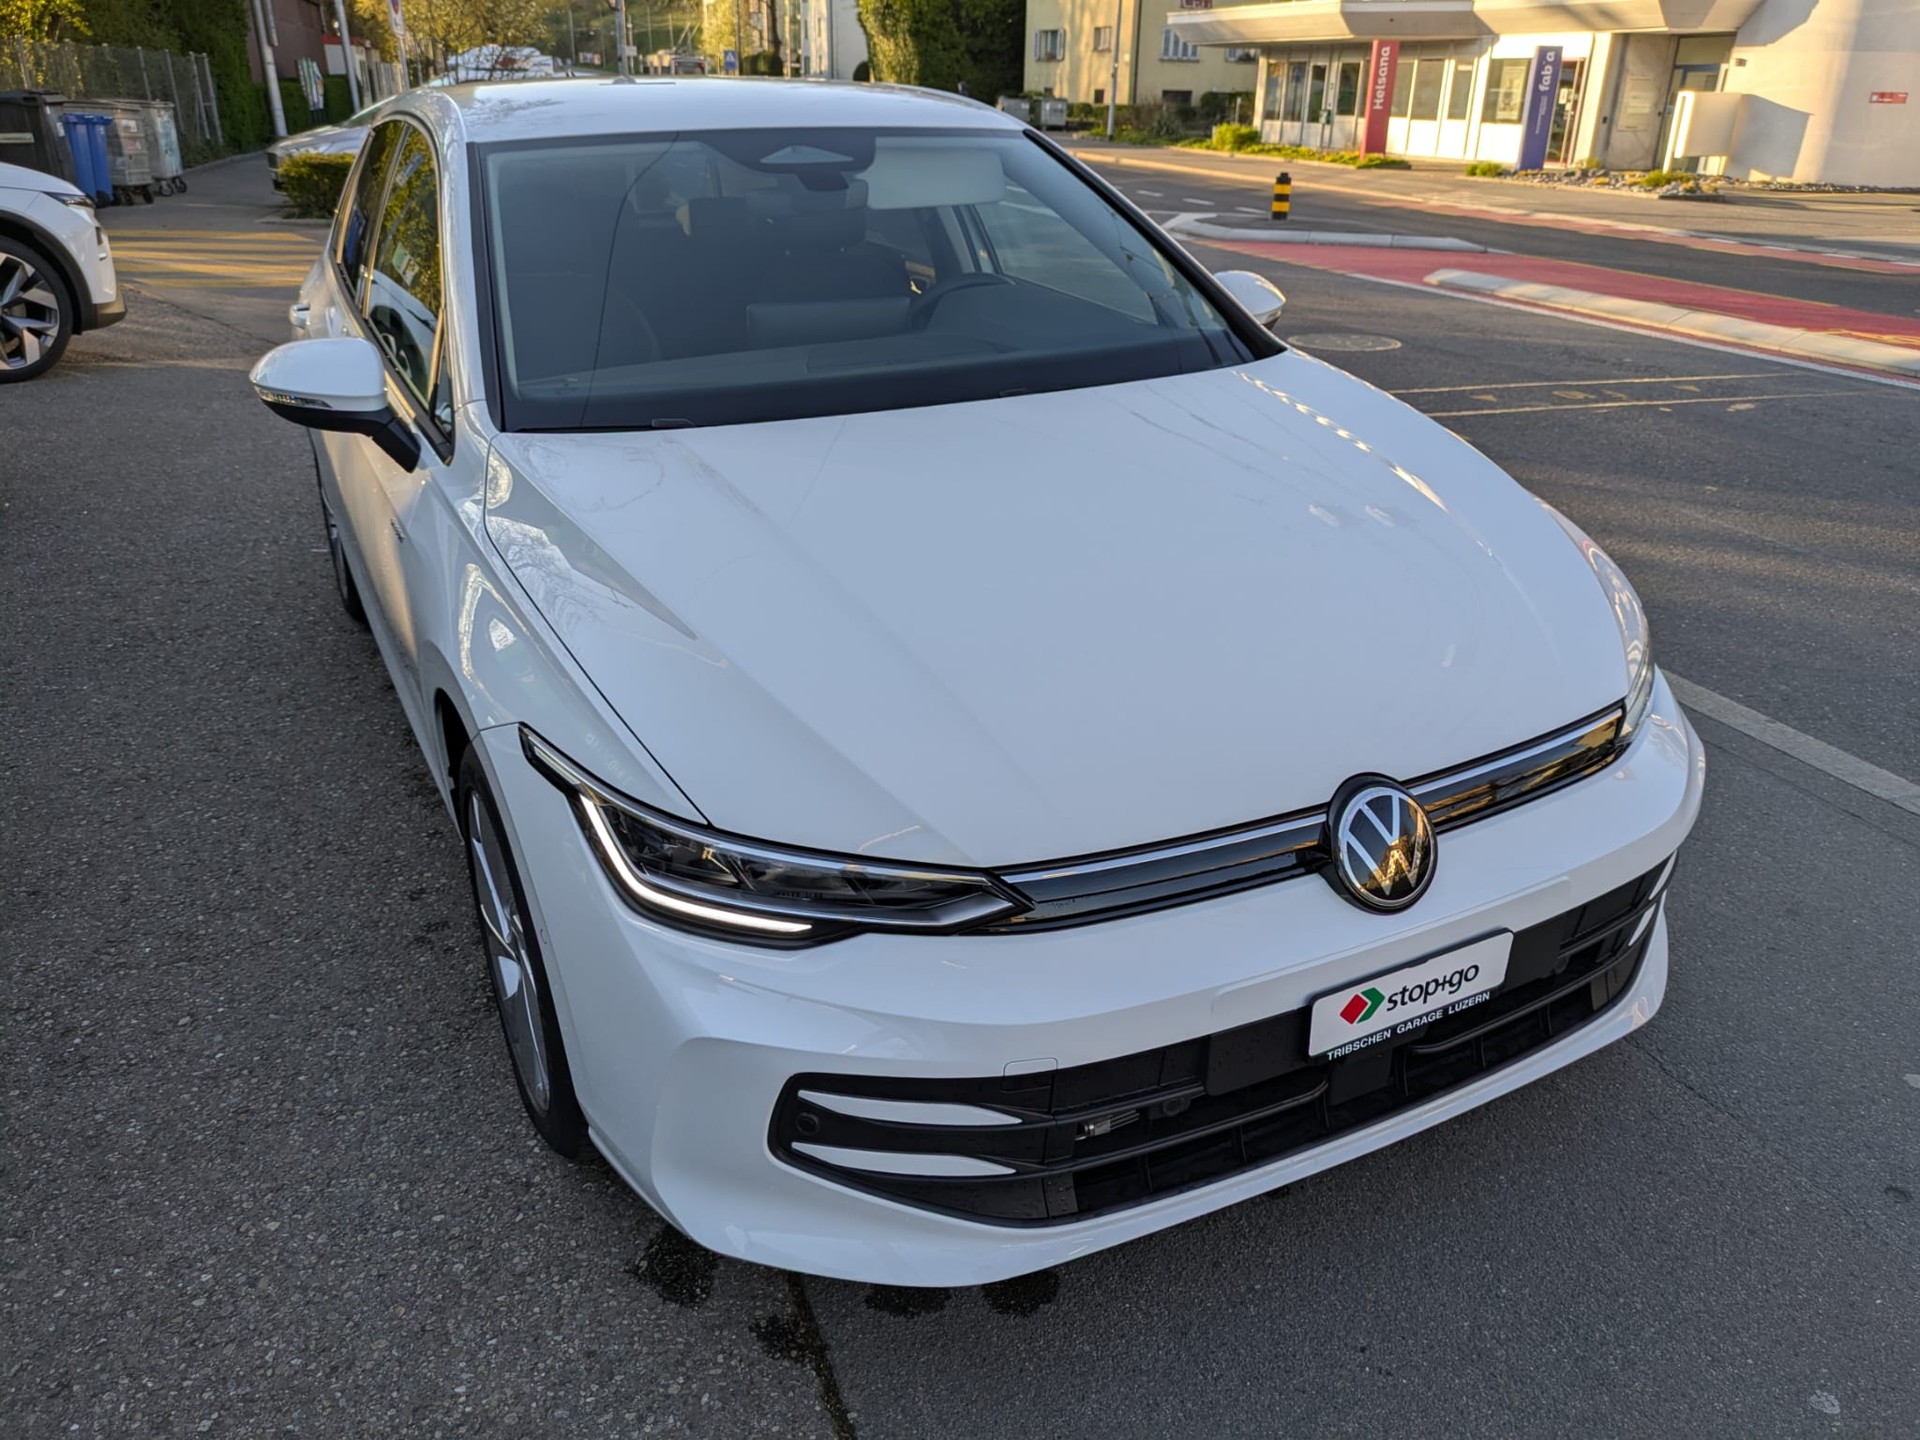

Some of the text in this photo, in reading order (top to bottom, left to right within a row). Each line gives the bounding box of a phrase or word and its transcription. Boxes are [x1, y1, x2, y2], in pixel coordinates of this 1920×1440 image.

[1373, 46, 1391, 110] Helsana
[1340, 789, 1432, 903] VW
[1386, 964, 1480, 1012] stop+go
[1327, 992, 1490, 1061] TRIBSCHEN GARAGE LUZERN
